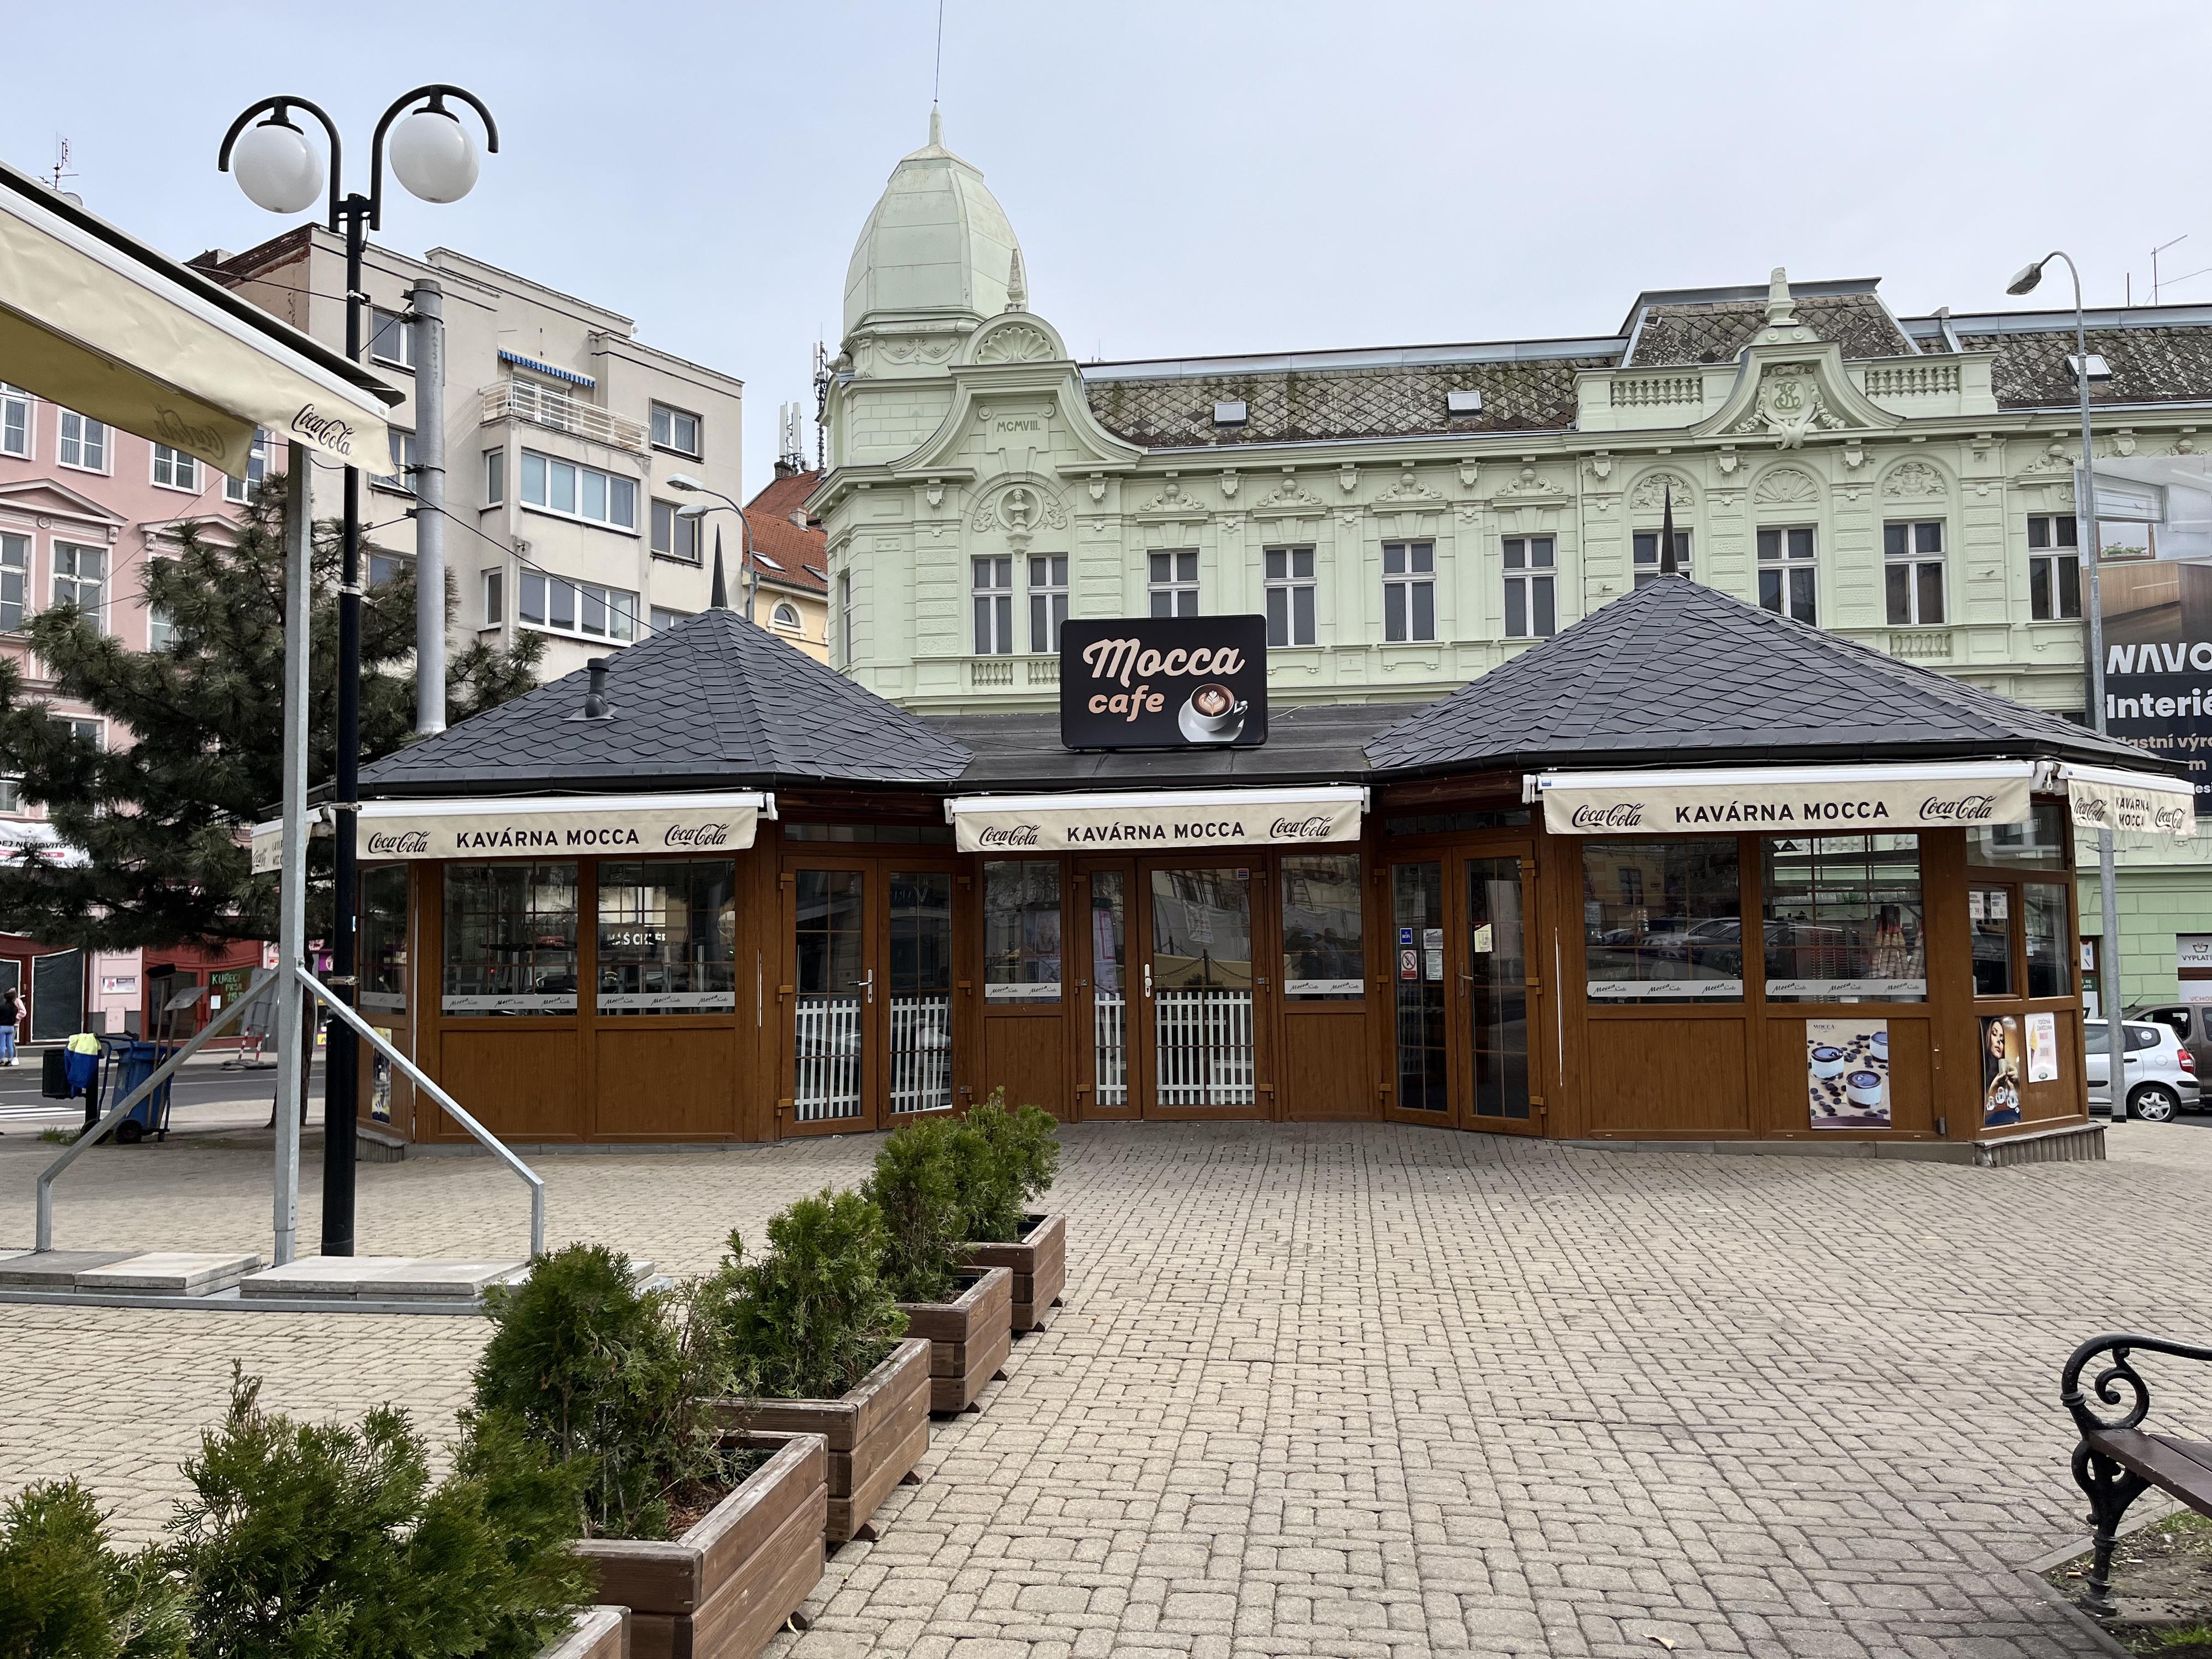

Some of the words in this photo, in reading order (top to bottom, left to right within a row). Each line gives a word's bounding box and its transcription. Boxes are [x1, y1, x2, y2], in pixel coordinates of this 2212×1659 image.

[291, 404, 356, 455] Coca-Cola
[1083, 638, 1245, 688] Mocca
[1088, 685, 1165, 722] cafe
[2117, 733, 2173, 749] lastní
[1572, 804, 1645, 827] Coca-Cola
[1676, 801, 1794, 823] KAVÁRNA
[1804, 801, 1889, 820] MOCCA
[1919, 795, 1997, 820] Coca-Cola
[2119, 813, 2145, 827] MOCCA
[368, 831, 431, 854] Coca-Cola
[457, 827, 558, 848] KAVÁRNA
[567, 829, 639, 845] MOCCA
[664, 823, 731, 846] Coca-Cola
[979, 825, 1041, 846] Coca-Cola
[1068, 822, 1166, 842] KAVÁRNA
[1174, 822, 1244, 838] MOCCA
[1270, 817, 1334, 838] Coca-Cola
